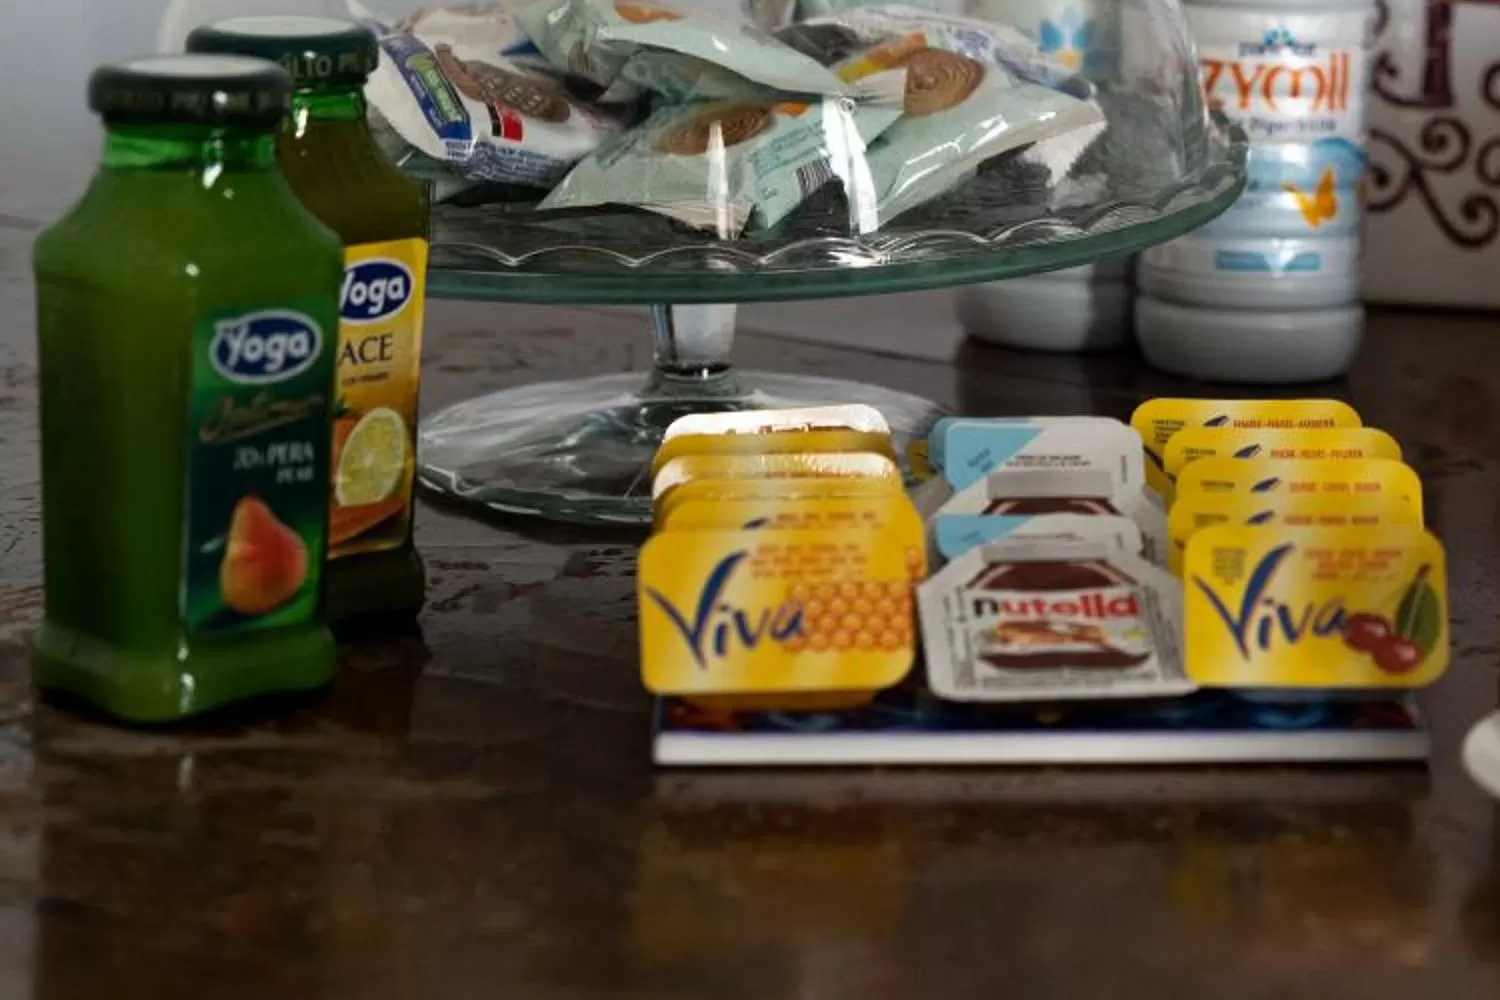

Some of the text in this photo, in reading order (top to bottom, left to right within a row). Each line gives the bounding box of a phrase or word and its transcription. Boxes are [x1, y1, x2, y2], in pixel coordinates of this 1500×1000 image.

[221, 324, 310, 373] Yoga
[338, 332, 394, 366] ACE
[645, 549, 805, 672] Viva
[972, 590, 1139, 618] nutella
[1191, 542, 1347, 664] Viva
